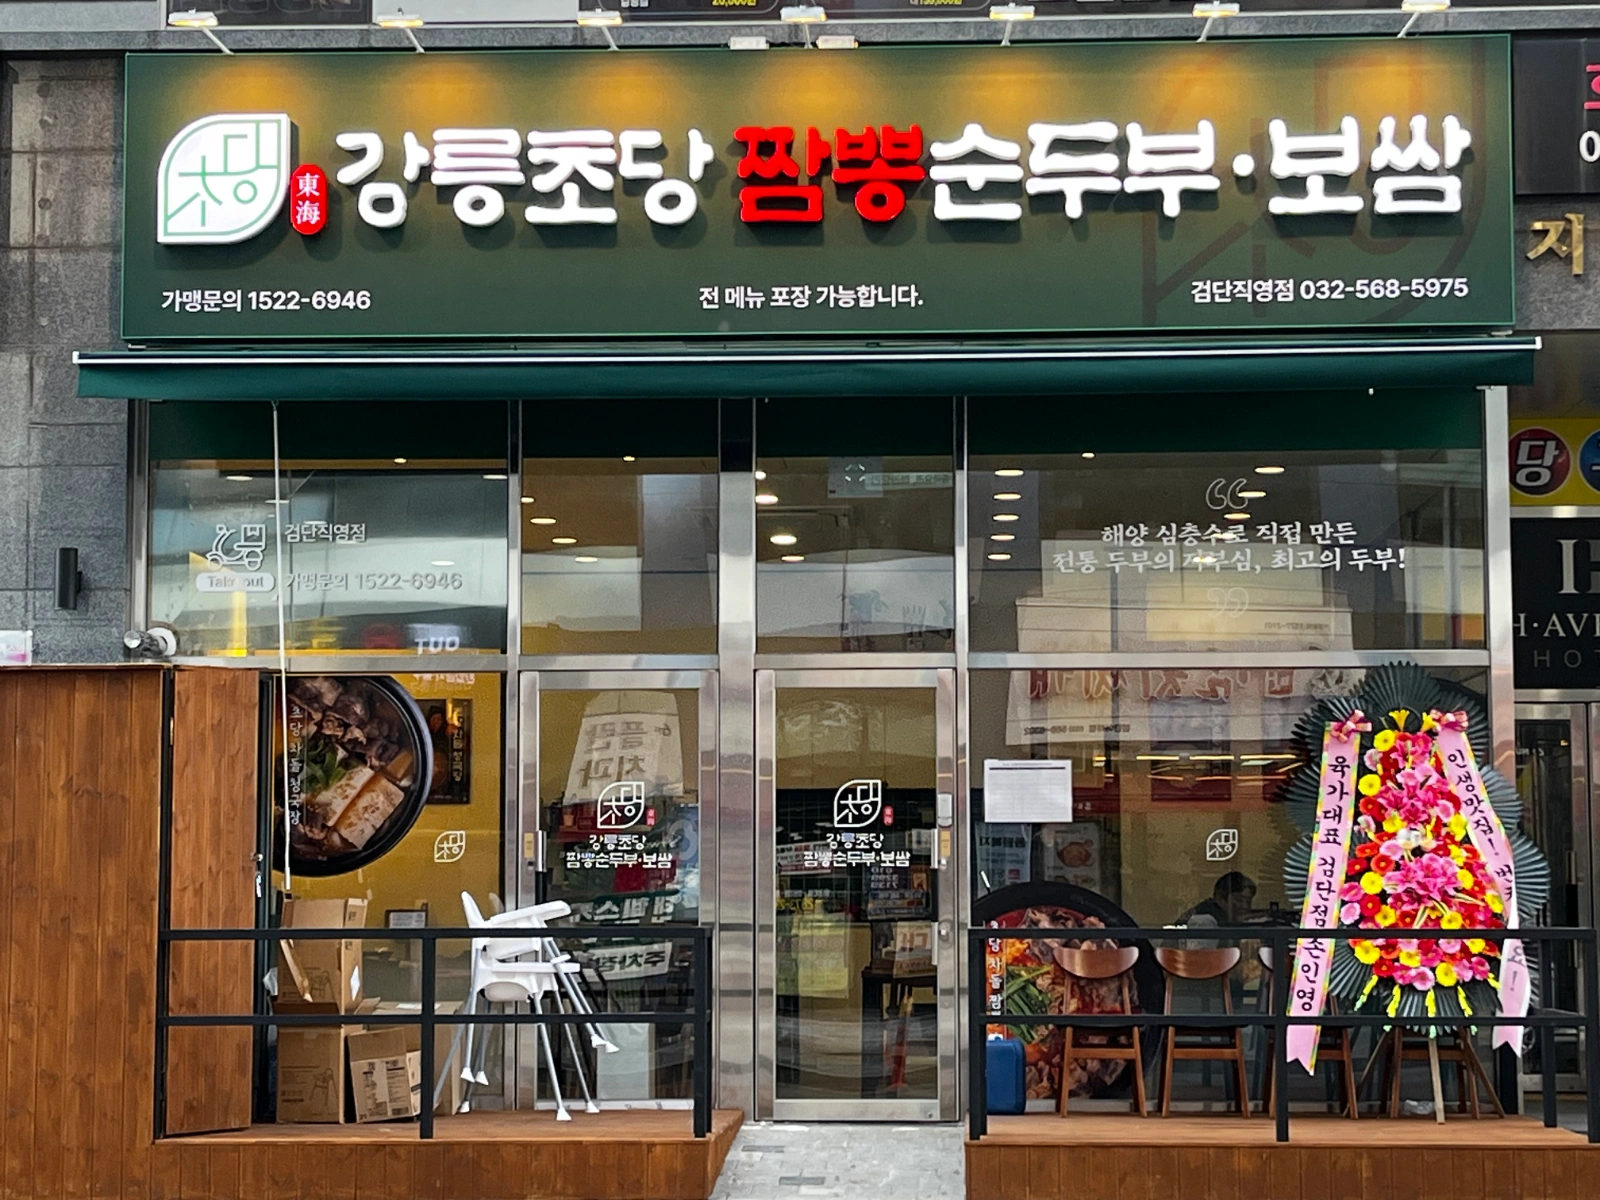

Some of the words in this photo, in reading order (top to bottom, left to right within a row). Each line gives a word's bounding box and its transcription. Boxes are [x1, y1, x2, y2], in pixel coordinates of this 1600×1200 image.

[335, 128, 713, 228] 강릉초당
[161, 290, 242, 312] 가맹문의
[248, 291, 371, 310] 1522-6946
[699, 287, 720, 309] 전
[725, 286, 766, 309] 메뉴
[770, 285, 811, 308] 포장
[815, 285, 924, 308] 가능합니다.
[1191, 278, 1294, 304] 검단직영점
[1299, 278, 1469, 300] 032-568-5975
[284, 522, 367, 543] 검단직영점
[1100, 522, 1149, 547] 해양
[1256, 521, 1302, 545] 직접
[1309, 521, 1358, 545] 만든
[1053, 550, 1099, 574] 전통
[1105, 549, 1175, 574] 두부의
[1271, 547, 1341, 572] 최고의
[1348, 547, 1406, 571] 두부!
[287, 572, 349, 592] 가맹문의
[355, 572, 464, 591] 1522-6946
[1318, 755, 1351, 848] 육가대표
[1310, 856, 1337, 928] 검단점
